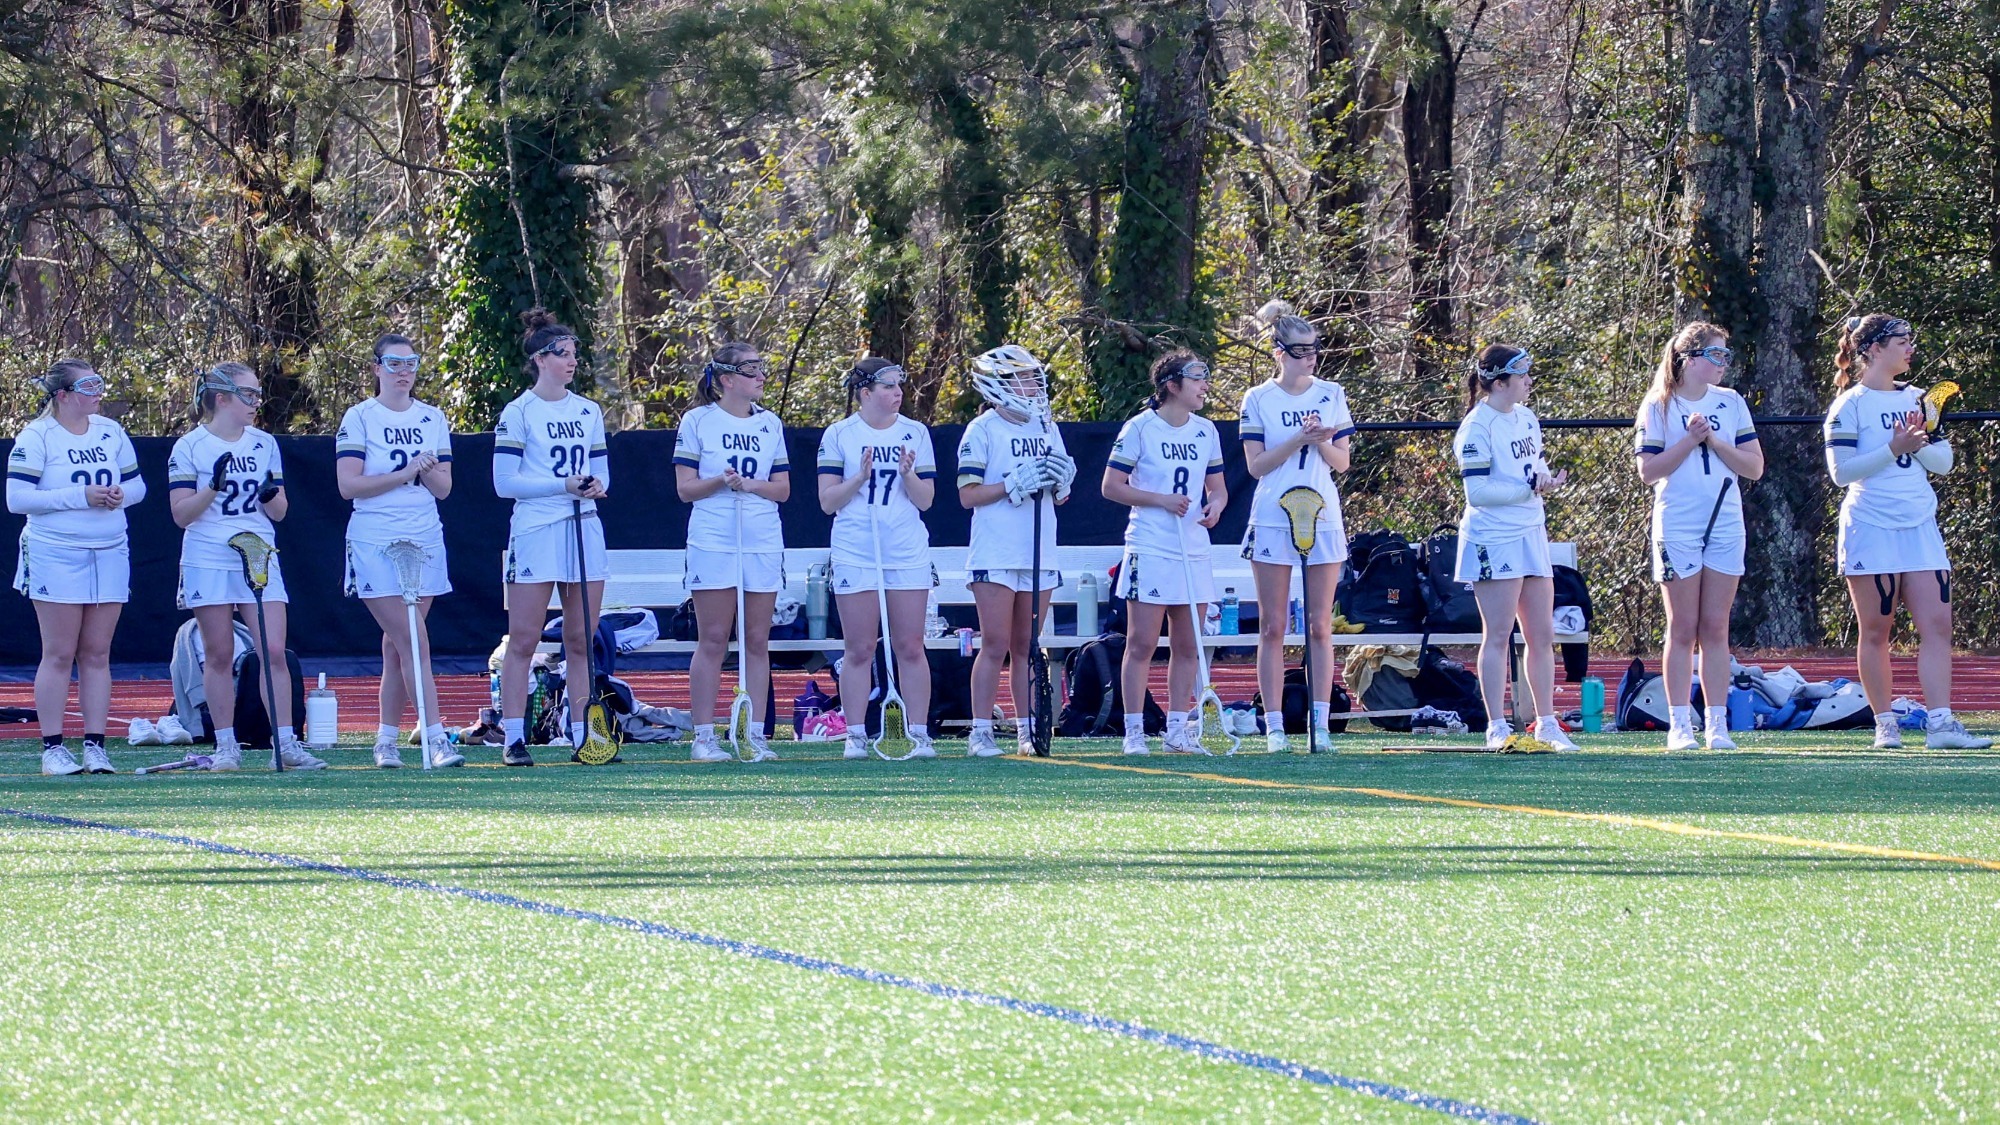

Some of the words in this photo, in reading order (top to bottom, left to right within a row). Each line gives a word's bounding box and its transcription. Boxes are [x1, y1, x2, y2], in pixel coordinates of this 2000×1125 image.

[547, 420, 585, 439] CAVS
[1681, 414, 1720, 431] CS
[1881, 410, 1914, 430] CAV
[383, 427, 423, 445] CAVS
[722, 433, 760, 453] CAVS
[67, 446, 108, 465] CAVS
[1011, 437, 1046, 458] CAVS
[1161, 442, 1199, 461] CAVS
[1510, 436, 1536, 460] CAVS
[228, 456, 257, 474] AVS
[550, 444, 585, 478] 20
[727, 455, 758, 492] 18
[1172, 466, 1190, 496] 8
[866, 468, 898, 506] 17
[221, 478, 259, 517] 22
